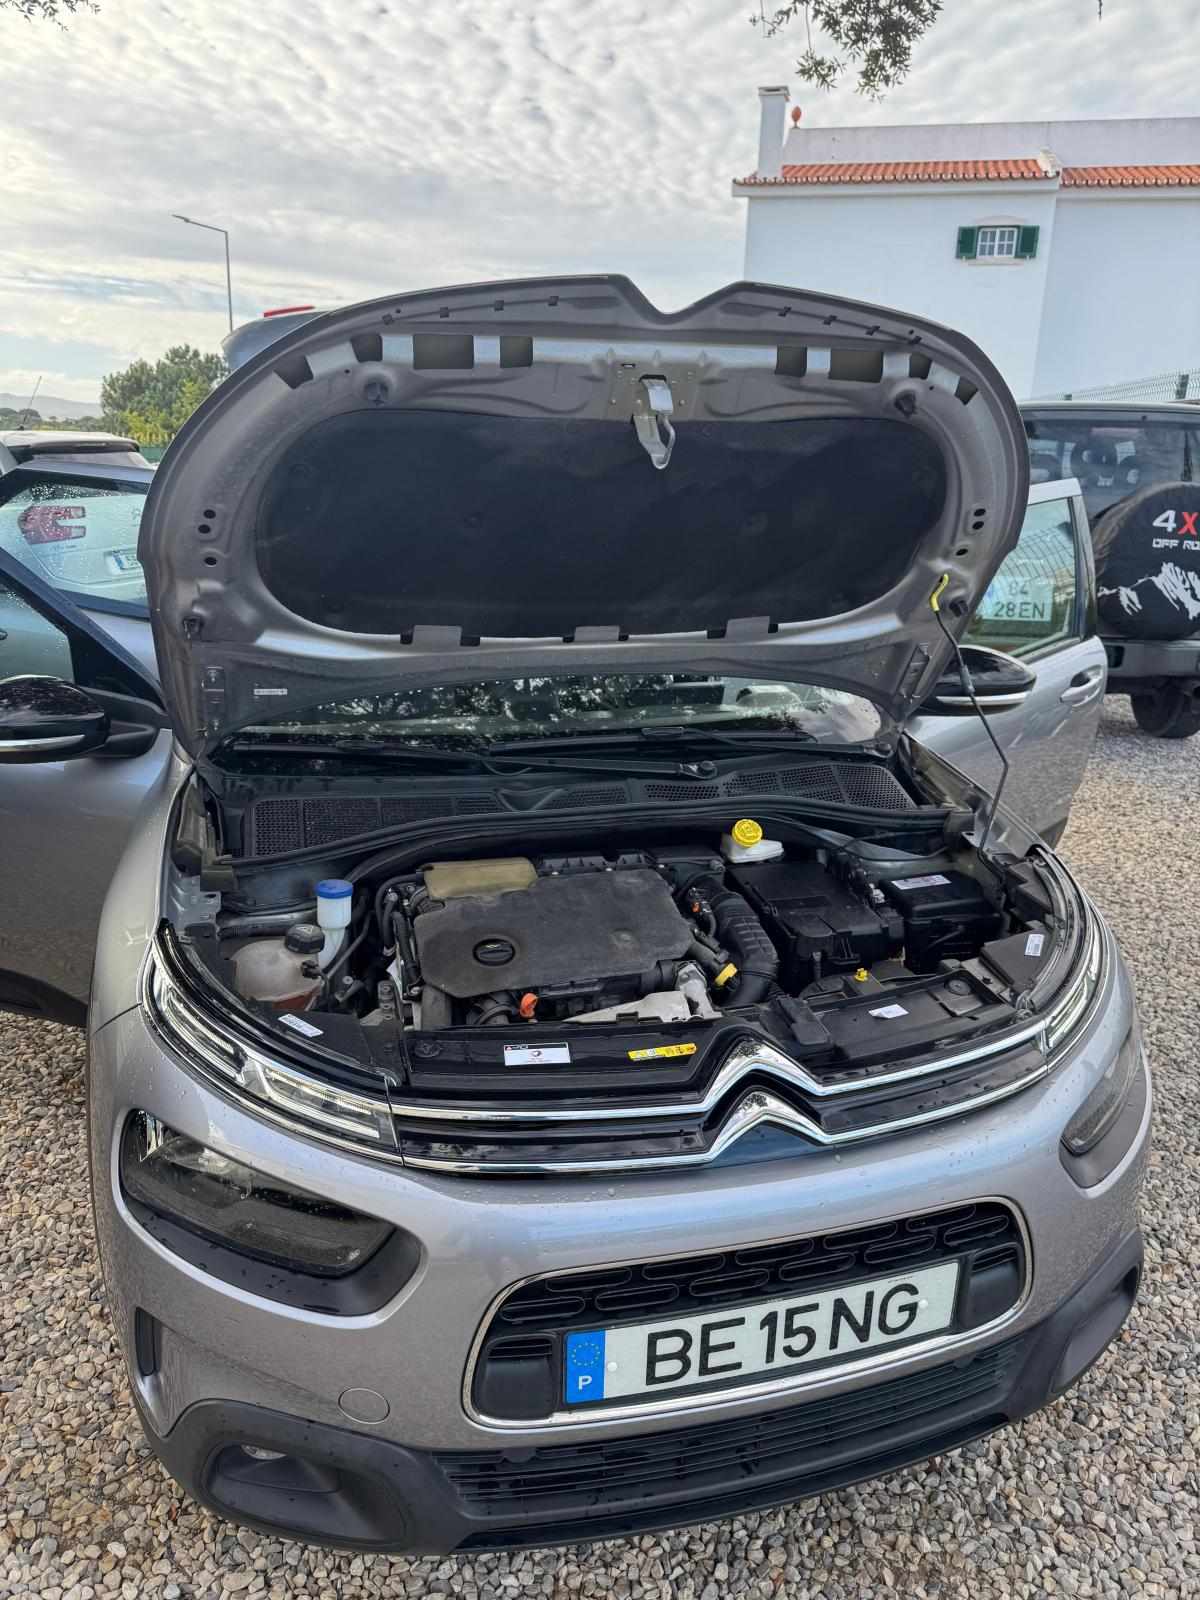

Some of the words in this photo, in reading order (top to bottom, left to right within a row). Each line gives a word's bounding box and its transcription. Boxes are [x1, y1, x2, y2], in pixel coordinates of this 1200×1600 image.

[1152, 538, 1179, 548] OFF
[646, 1317, 746, 1386] BE
[759, 1302, 820, 1364] 15
[829, 1283, 919, 1350] NG
[578, 1375, 593, 1391] P
